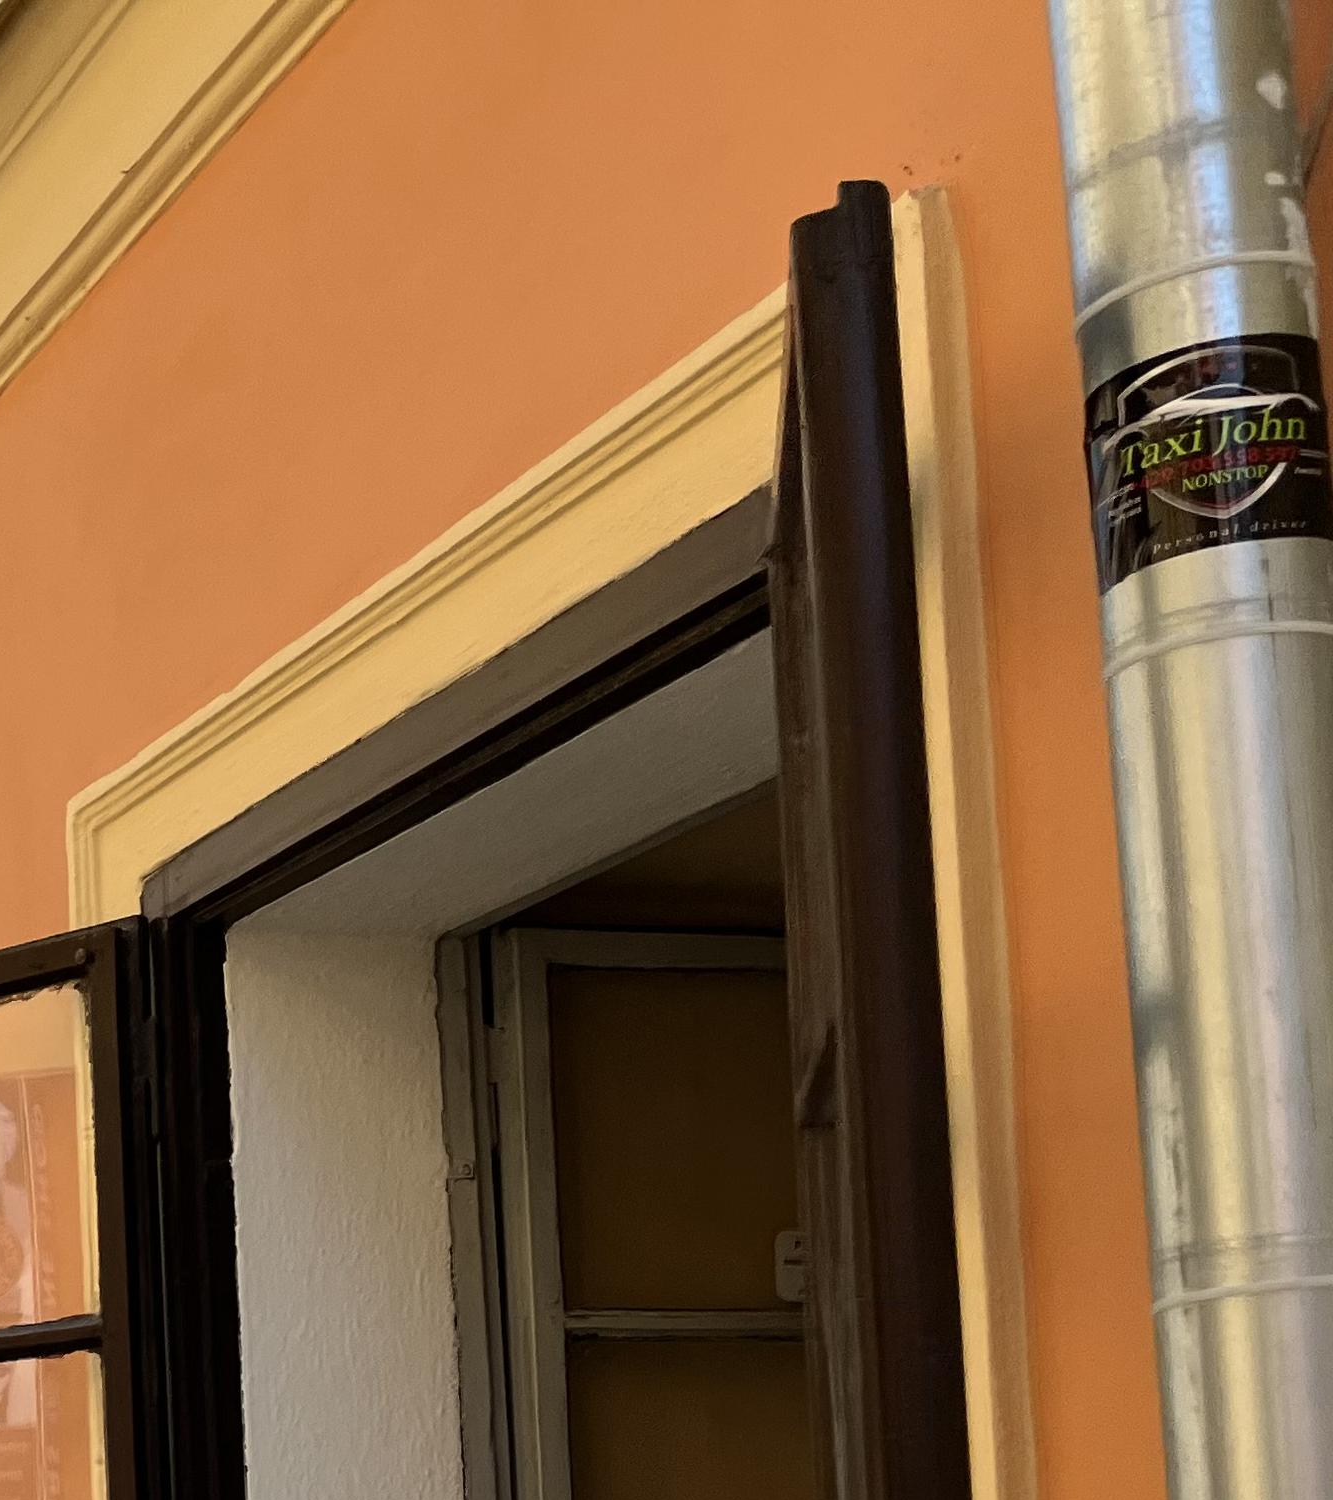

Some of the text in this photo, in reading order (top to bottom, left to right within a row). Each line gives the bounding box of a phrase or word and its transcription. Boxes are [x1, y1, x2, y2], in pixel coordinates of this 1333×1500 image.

[1120, 408, 1307, 478] Taxi John
[1182, 464, 1269, 493] NONSTOP
